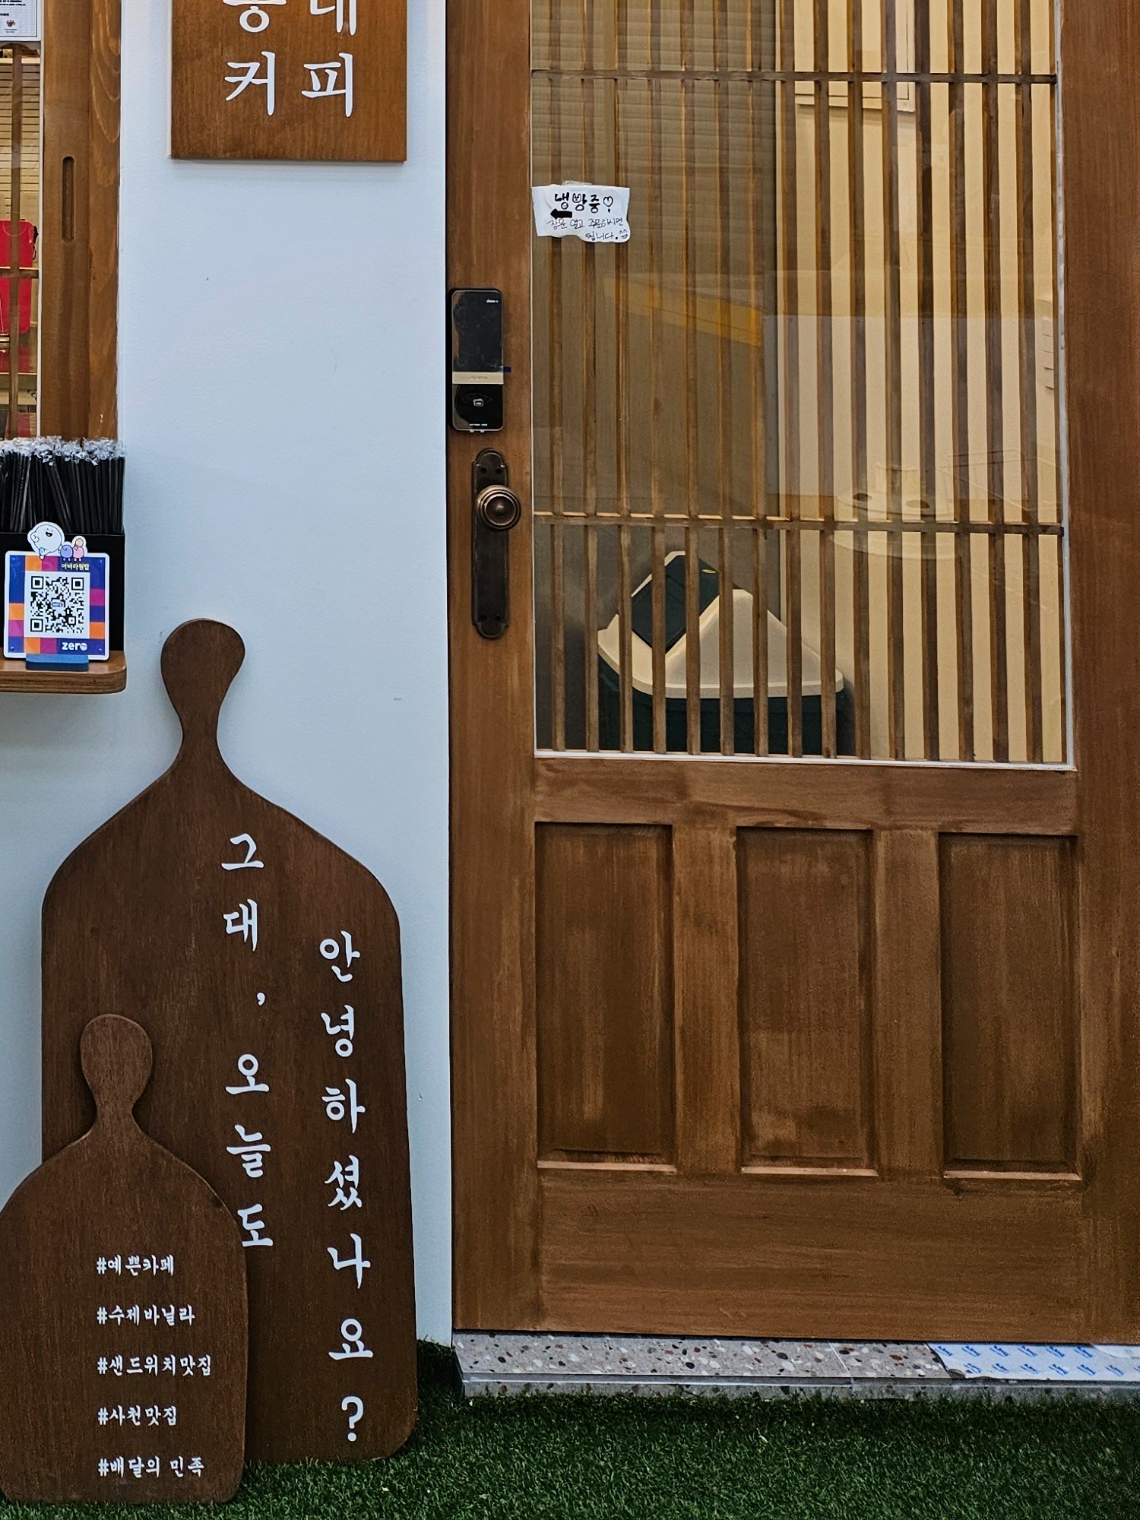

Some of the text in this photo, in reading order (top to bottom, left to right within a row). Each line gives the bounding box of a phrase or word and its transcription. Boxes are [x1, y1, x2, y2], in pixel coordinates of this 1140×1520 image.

[224, 51, 353, 118] 커피
[554, 191, 601, 213] 냉방중
[221, 833, 265, 1006] 그대,
[225, 1053, 274, 1248] 오늘도
[319, 930, 374, 1442] 안녕하셨나요?
[96, 1255, 175, 1277] #예쁜카페
[96, 1305, 196, 1327] #수제바닐라
[97, 1354, 212, 1377] #샌드위치맛집
[97, 1405, 178, 1427] #사천맛집
[97, 1456, 205, 1478] #배달의 민족
